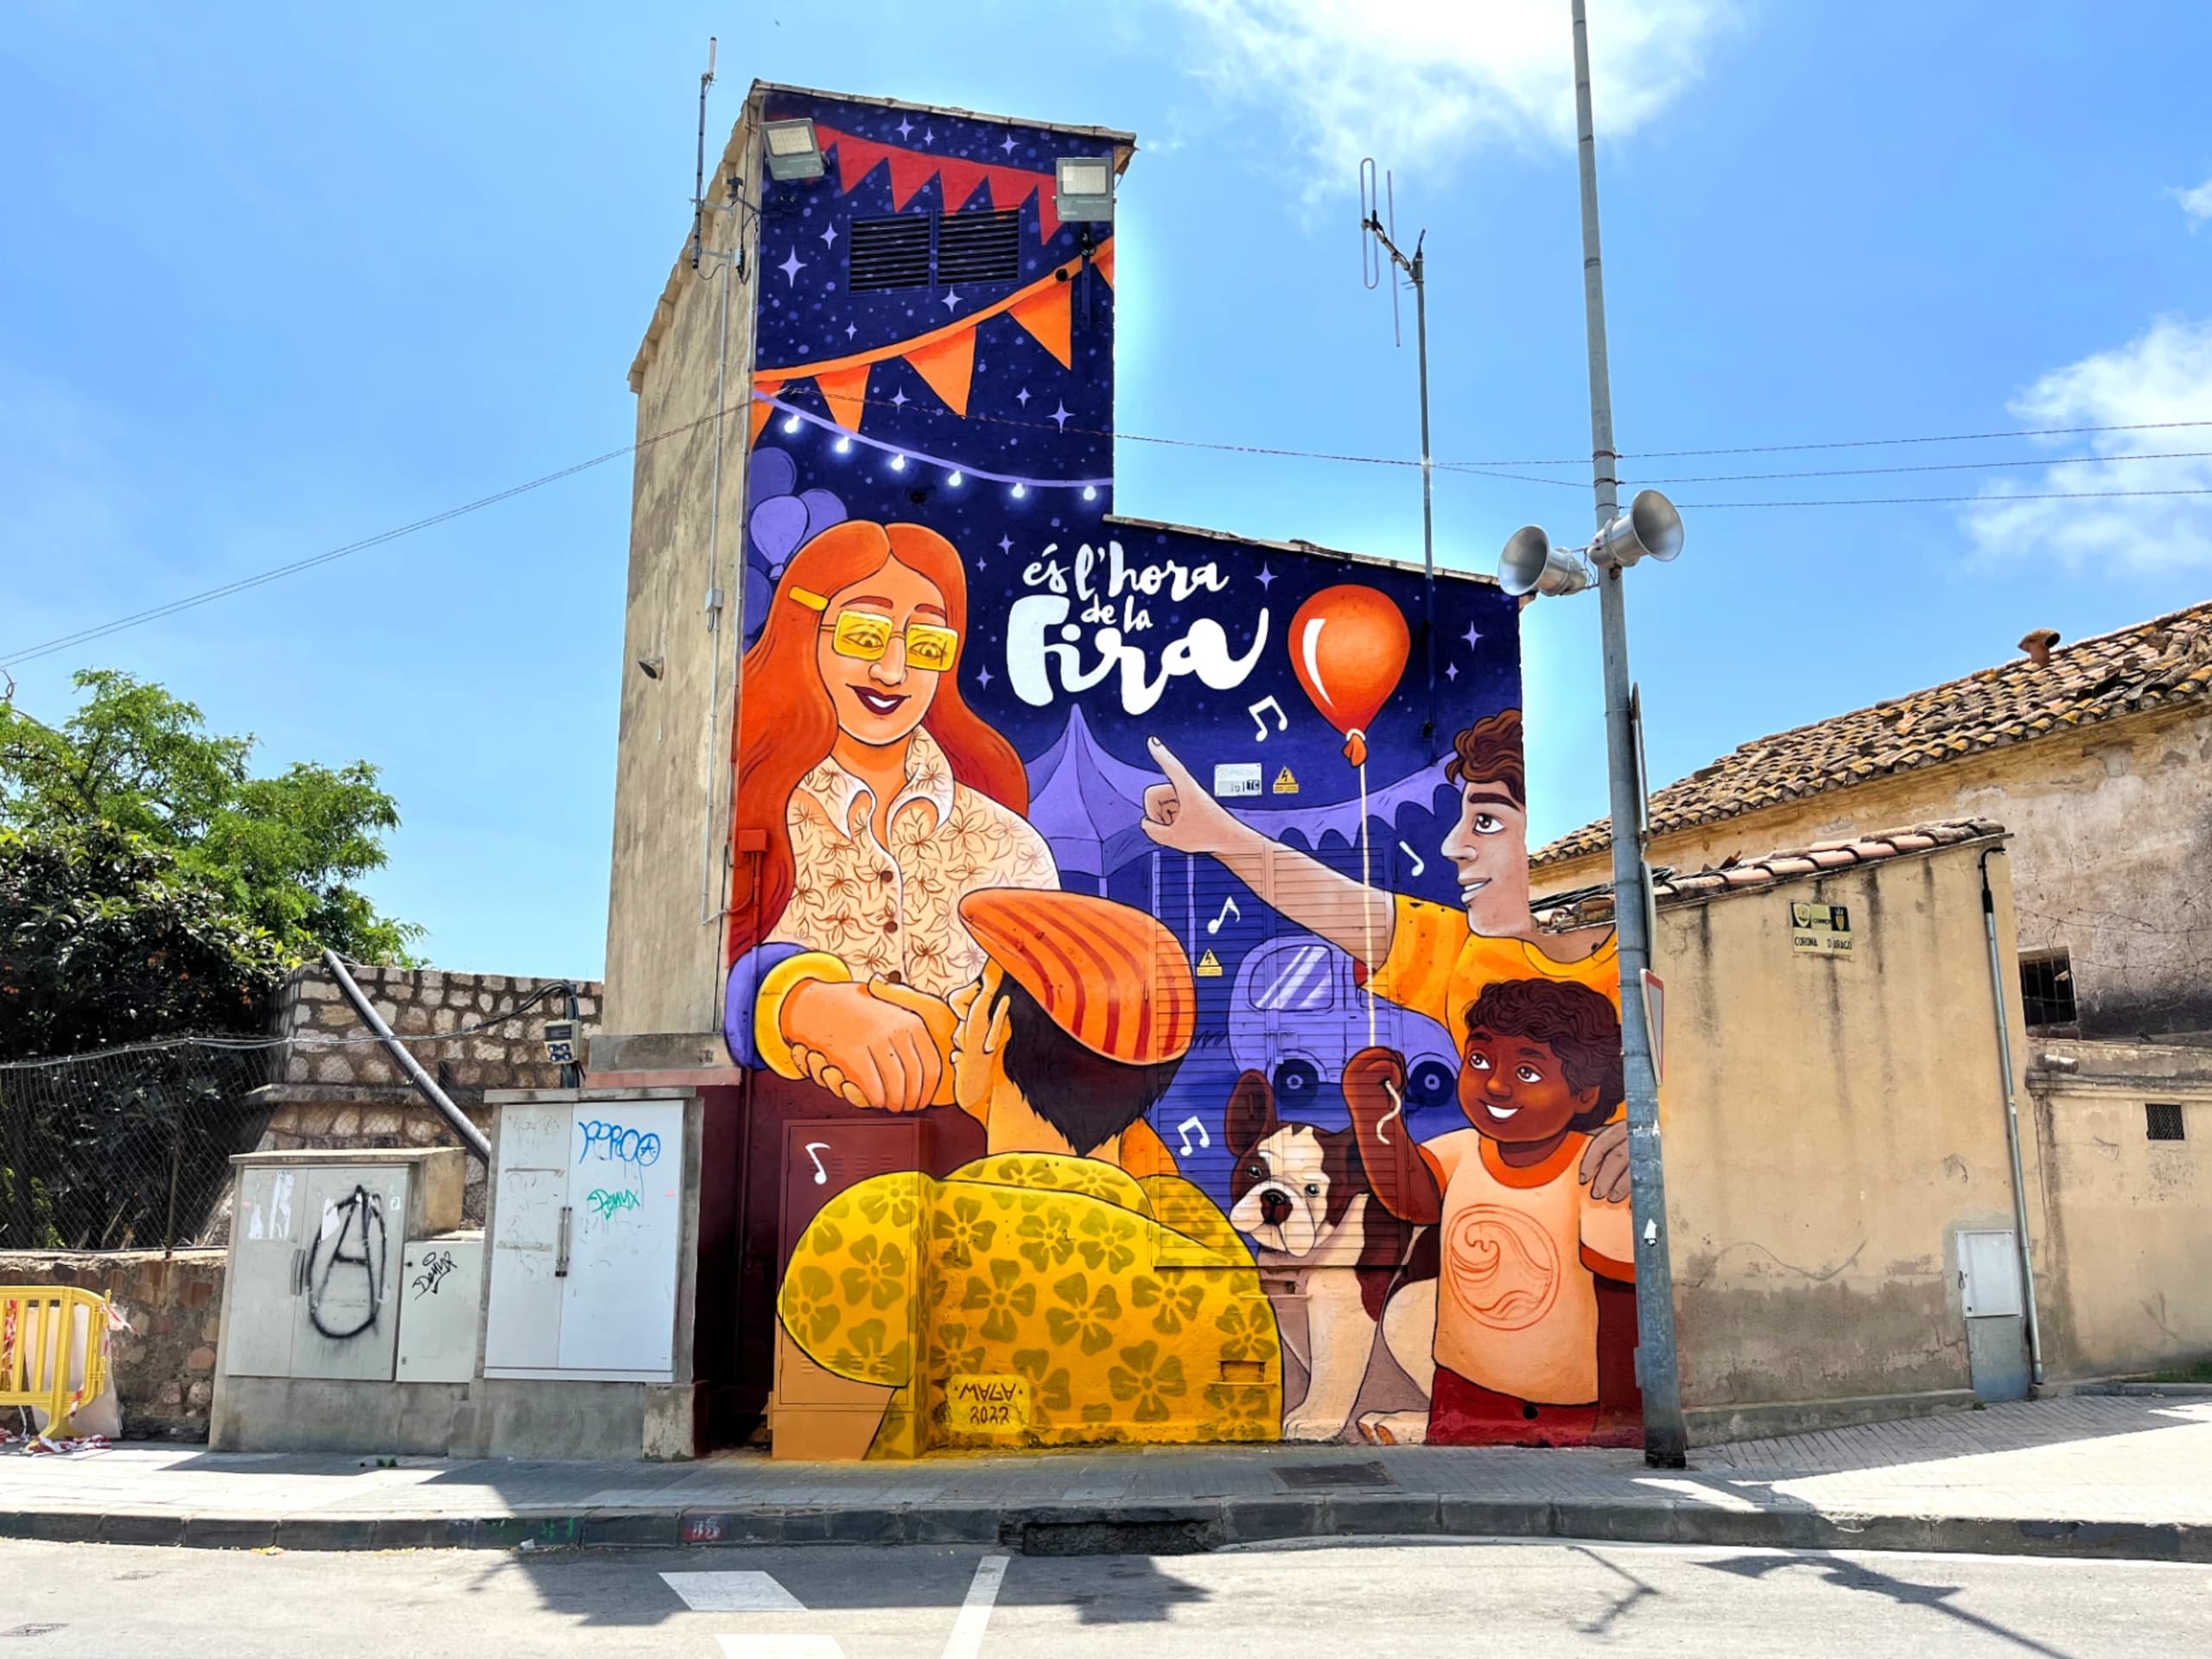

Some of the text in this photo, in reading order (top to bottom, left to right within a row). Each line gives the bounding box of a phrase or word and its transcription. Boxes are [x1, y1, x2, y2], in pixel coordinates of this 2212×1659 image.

[1022, 540, 1230, 602] és l'hora
[1080, 593, 1154, 634] de la
[1006, 594, 1269, 715] Fira
[969, 1405, 1010, 1425] 2022
